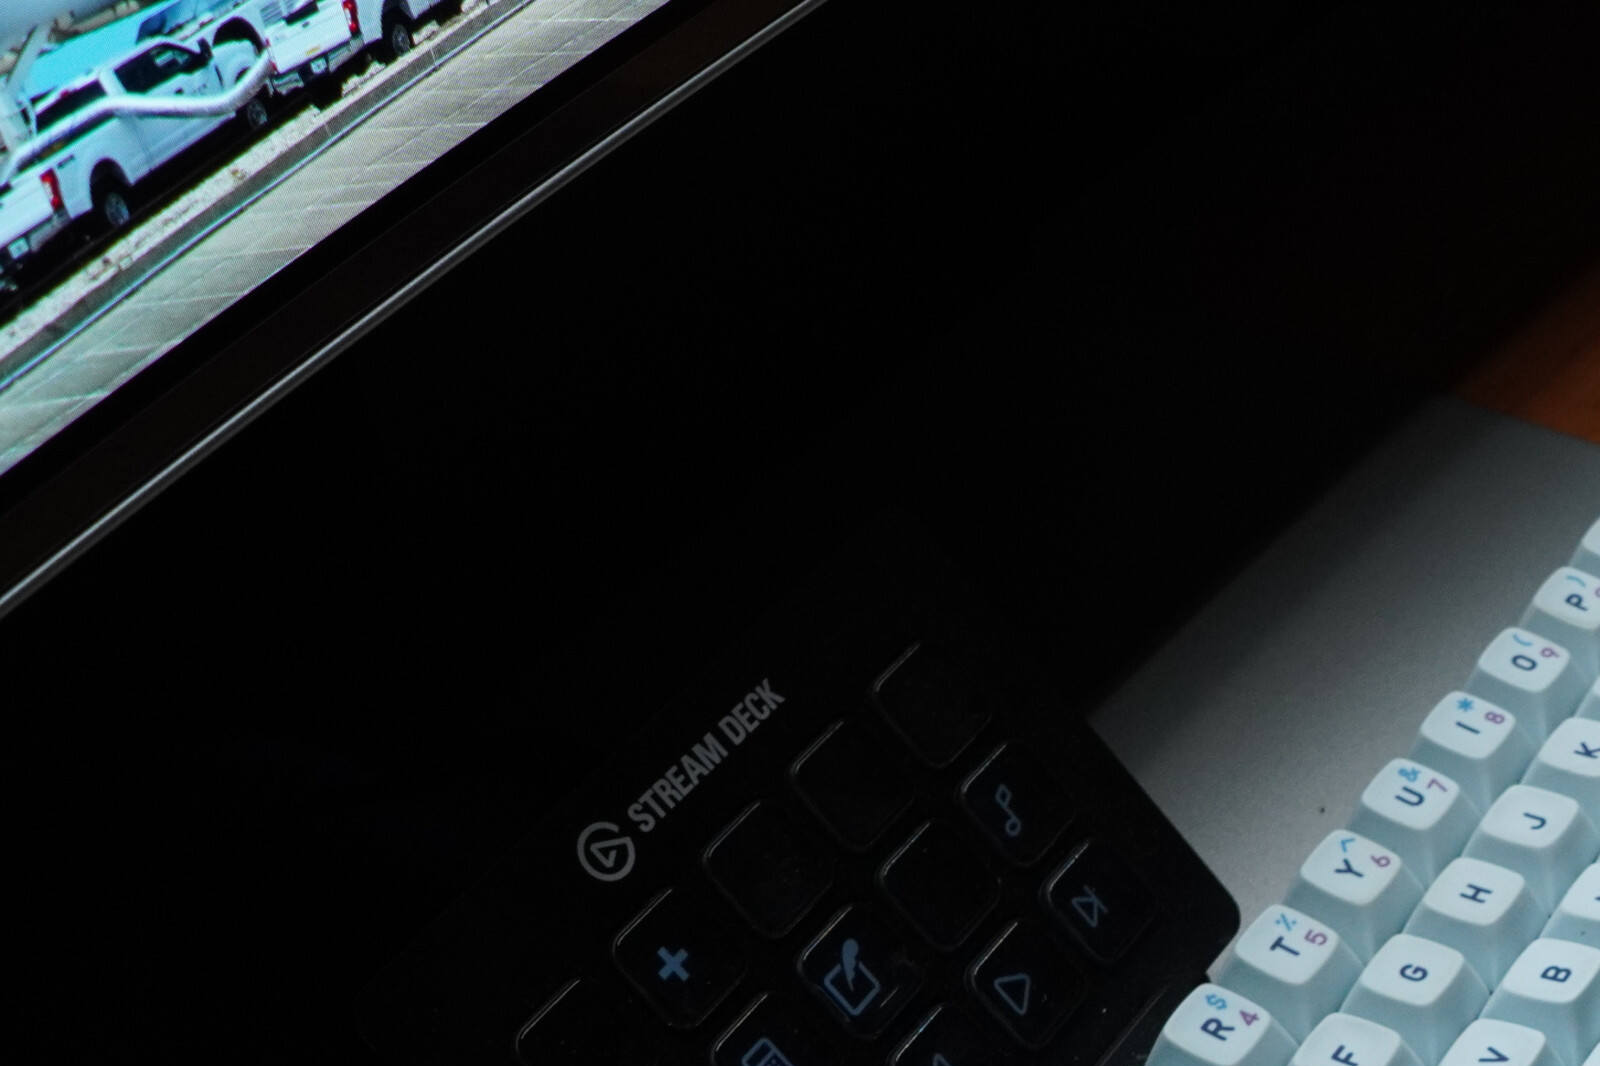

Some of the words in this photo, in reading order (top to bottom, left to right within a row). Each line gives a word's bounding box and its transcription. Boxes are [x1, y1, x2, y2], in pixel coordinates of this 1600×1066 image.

[1565, 594, 1587, 611] P
[1540, 647, 1559, 658] 9
[1511, 655, 1537, 671] O
[1484, 710, 1505, 724] 8
[627, 732, 729, 833] STREAM
[717, 678, 786, 746] DECK
[1427, 778, 1448, 792] 7
[1395, 786, 1425, 807] U
[1524, 813, 1546, 829] J
[1335, 859, 1363, 877] Y
[1371, 853, 1391, 868] 6
[1460, 884, 1492, 903] H
[1304, 928, 1328, 945] 5
[1270, 936, 1300, 955] T
[1400, 964, 1428, 981] G
[1541, 966, 1571, 982] B
[1239, 1008, 1259, 1026] 4
[1201, 1018, 1235, 1041] R
[1331, 1045, 1358, 1066] F
[1479, 1047, 1509, 1062] V
